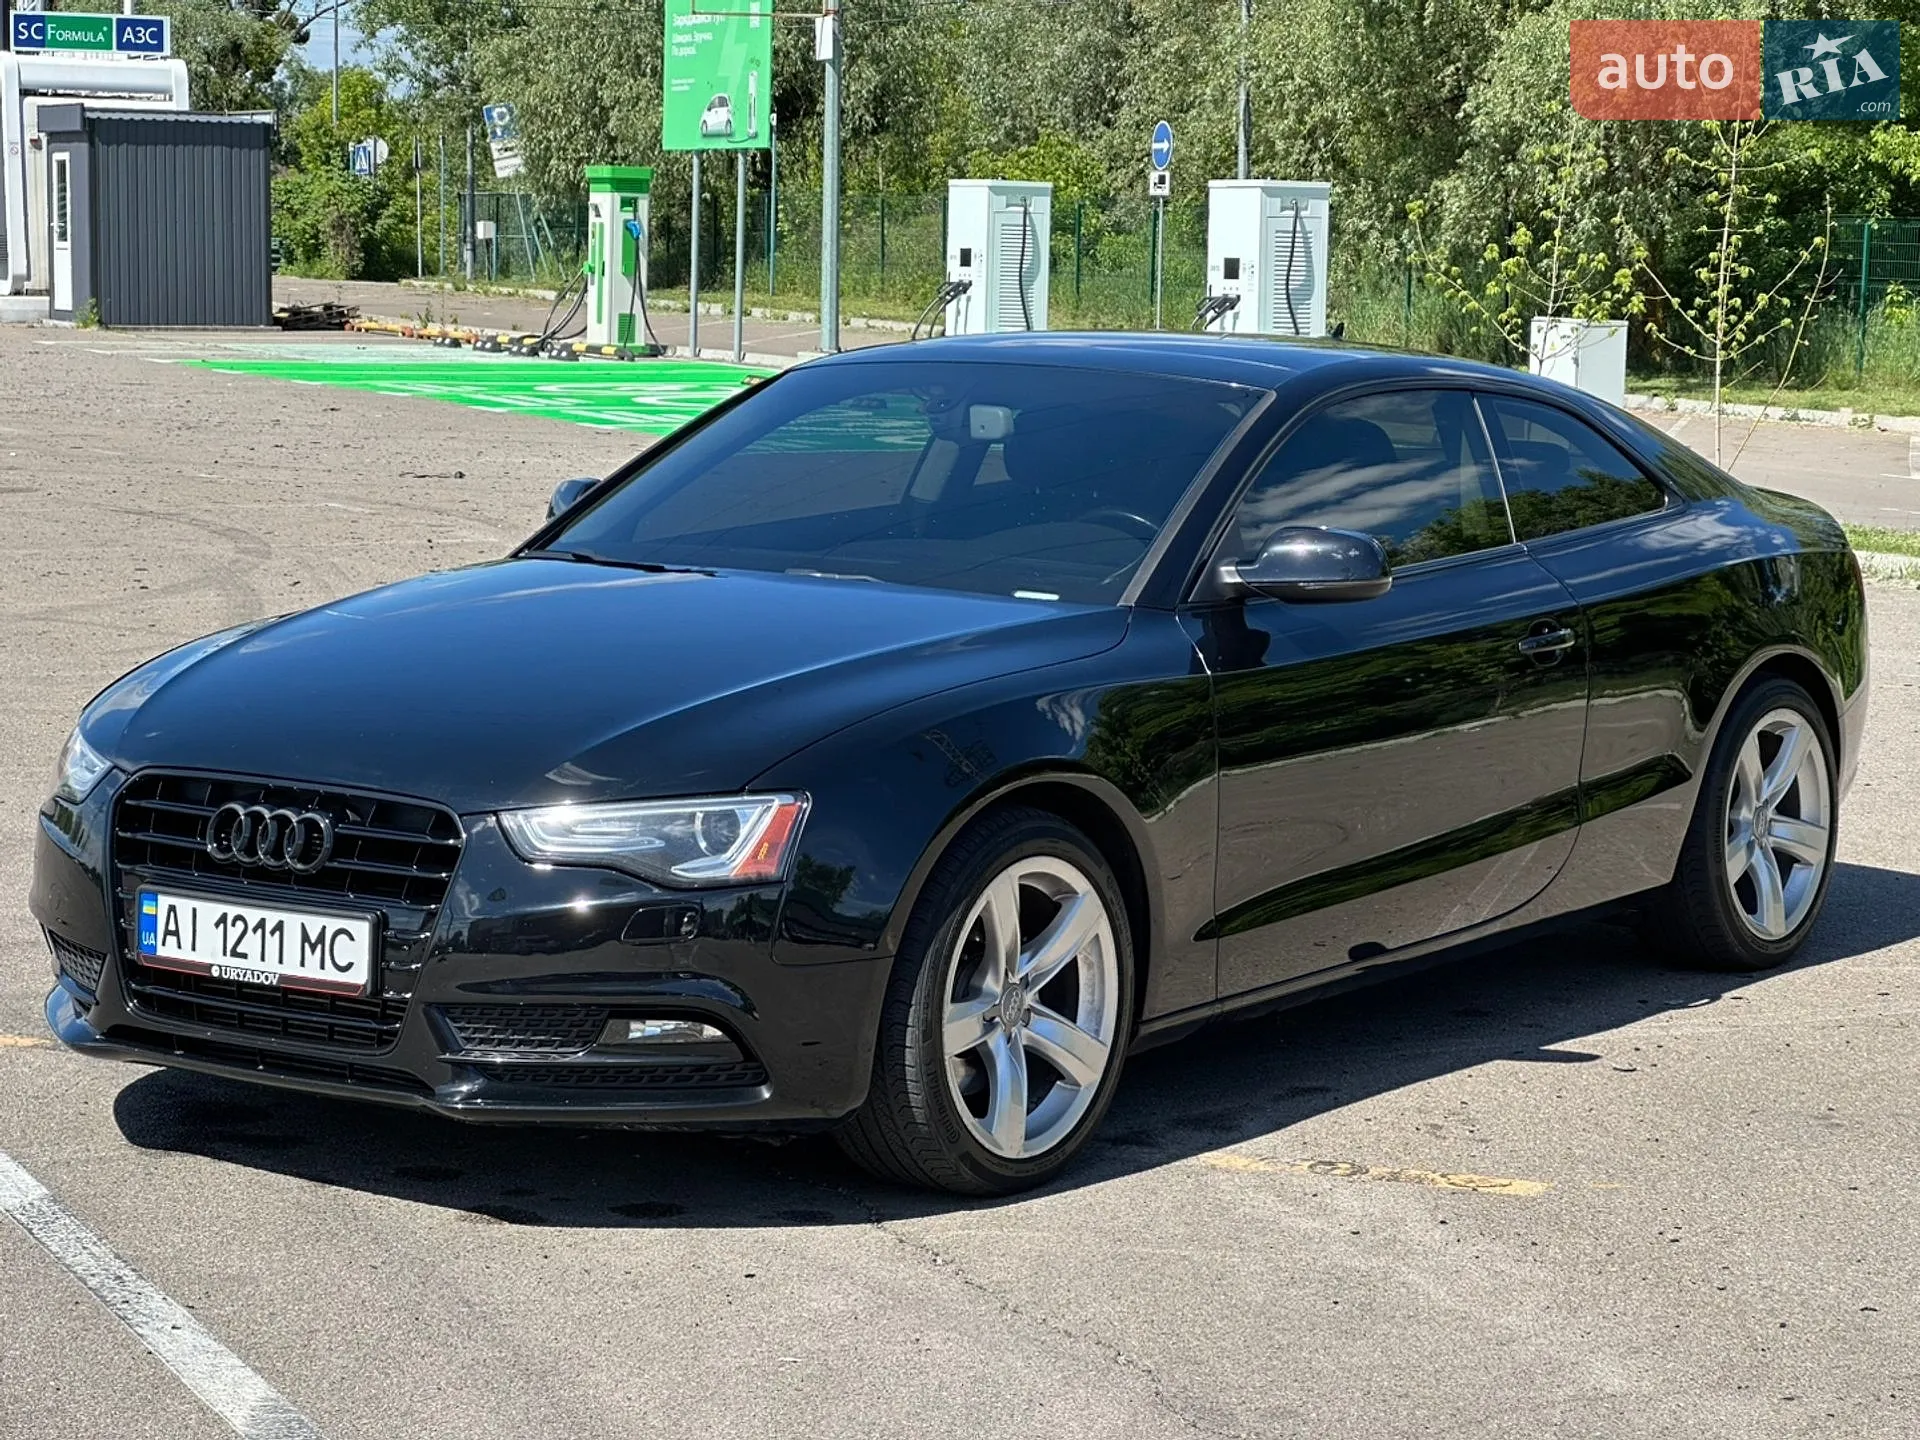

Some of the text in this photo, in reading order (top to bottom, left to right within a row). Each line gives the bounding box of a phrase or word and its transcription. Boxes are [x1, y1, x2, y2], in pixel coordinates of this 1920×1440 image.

[18, 22, 44, 40] SC
[142, 930, 156, 945] UA
[161, 904, 356, 973] AI 1211 MC
[221, 966, 280, 985] URYADOV
